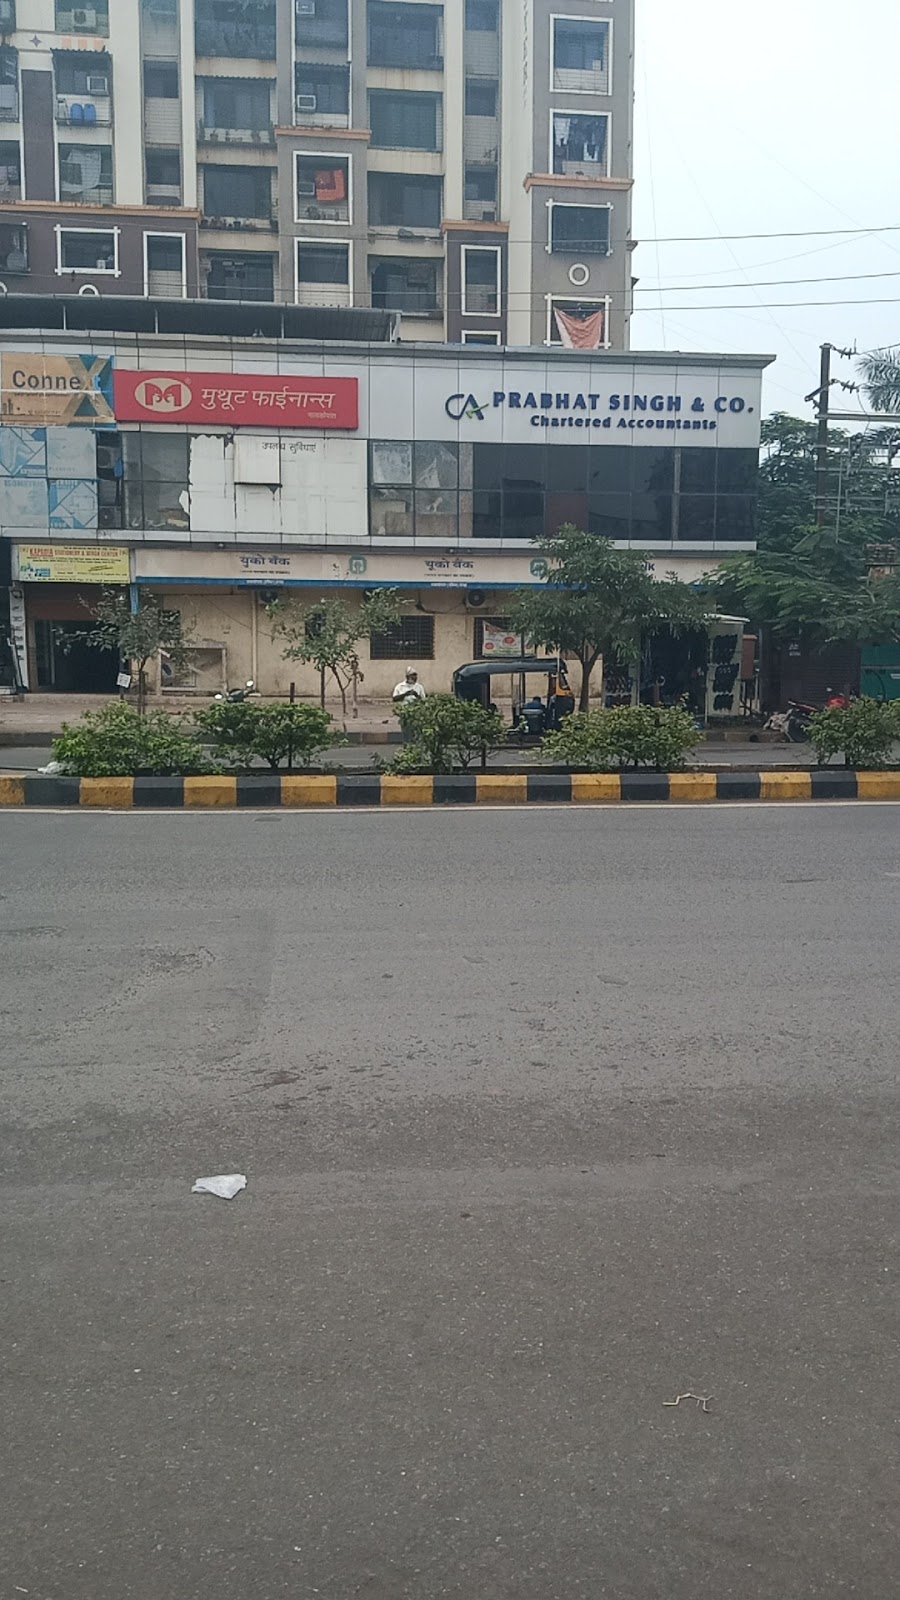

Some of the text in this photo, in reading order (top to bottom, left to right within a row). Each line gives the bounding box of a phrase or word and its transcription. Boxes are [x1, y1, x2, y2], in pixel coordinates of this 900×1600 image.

[201, 385, 337, 411] मुथूट फाईनान्स
[493, 391, 754, 413] PRABHAT SINGH & CO.
[530, 415, 717, 430] Chartered Accountants
